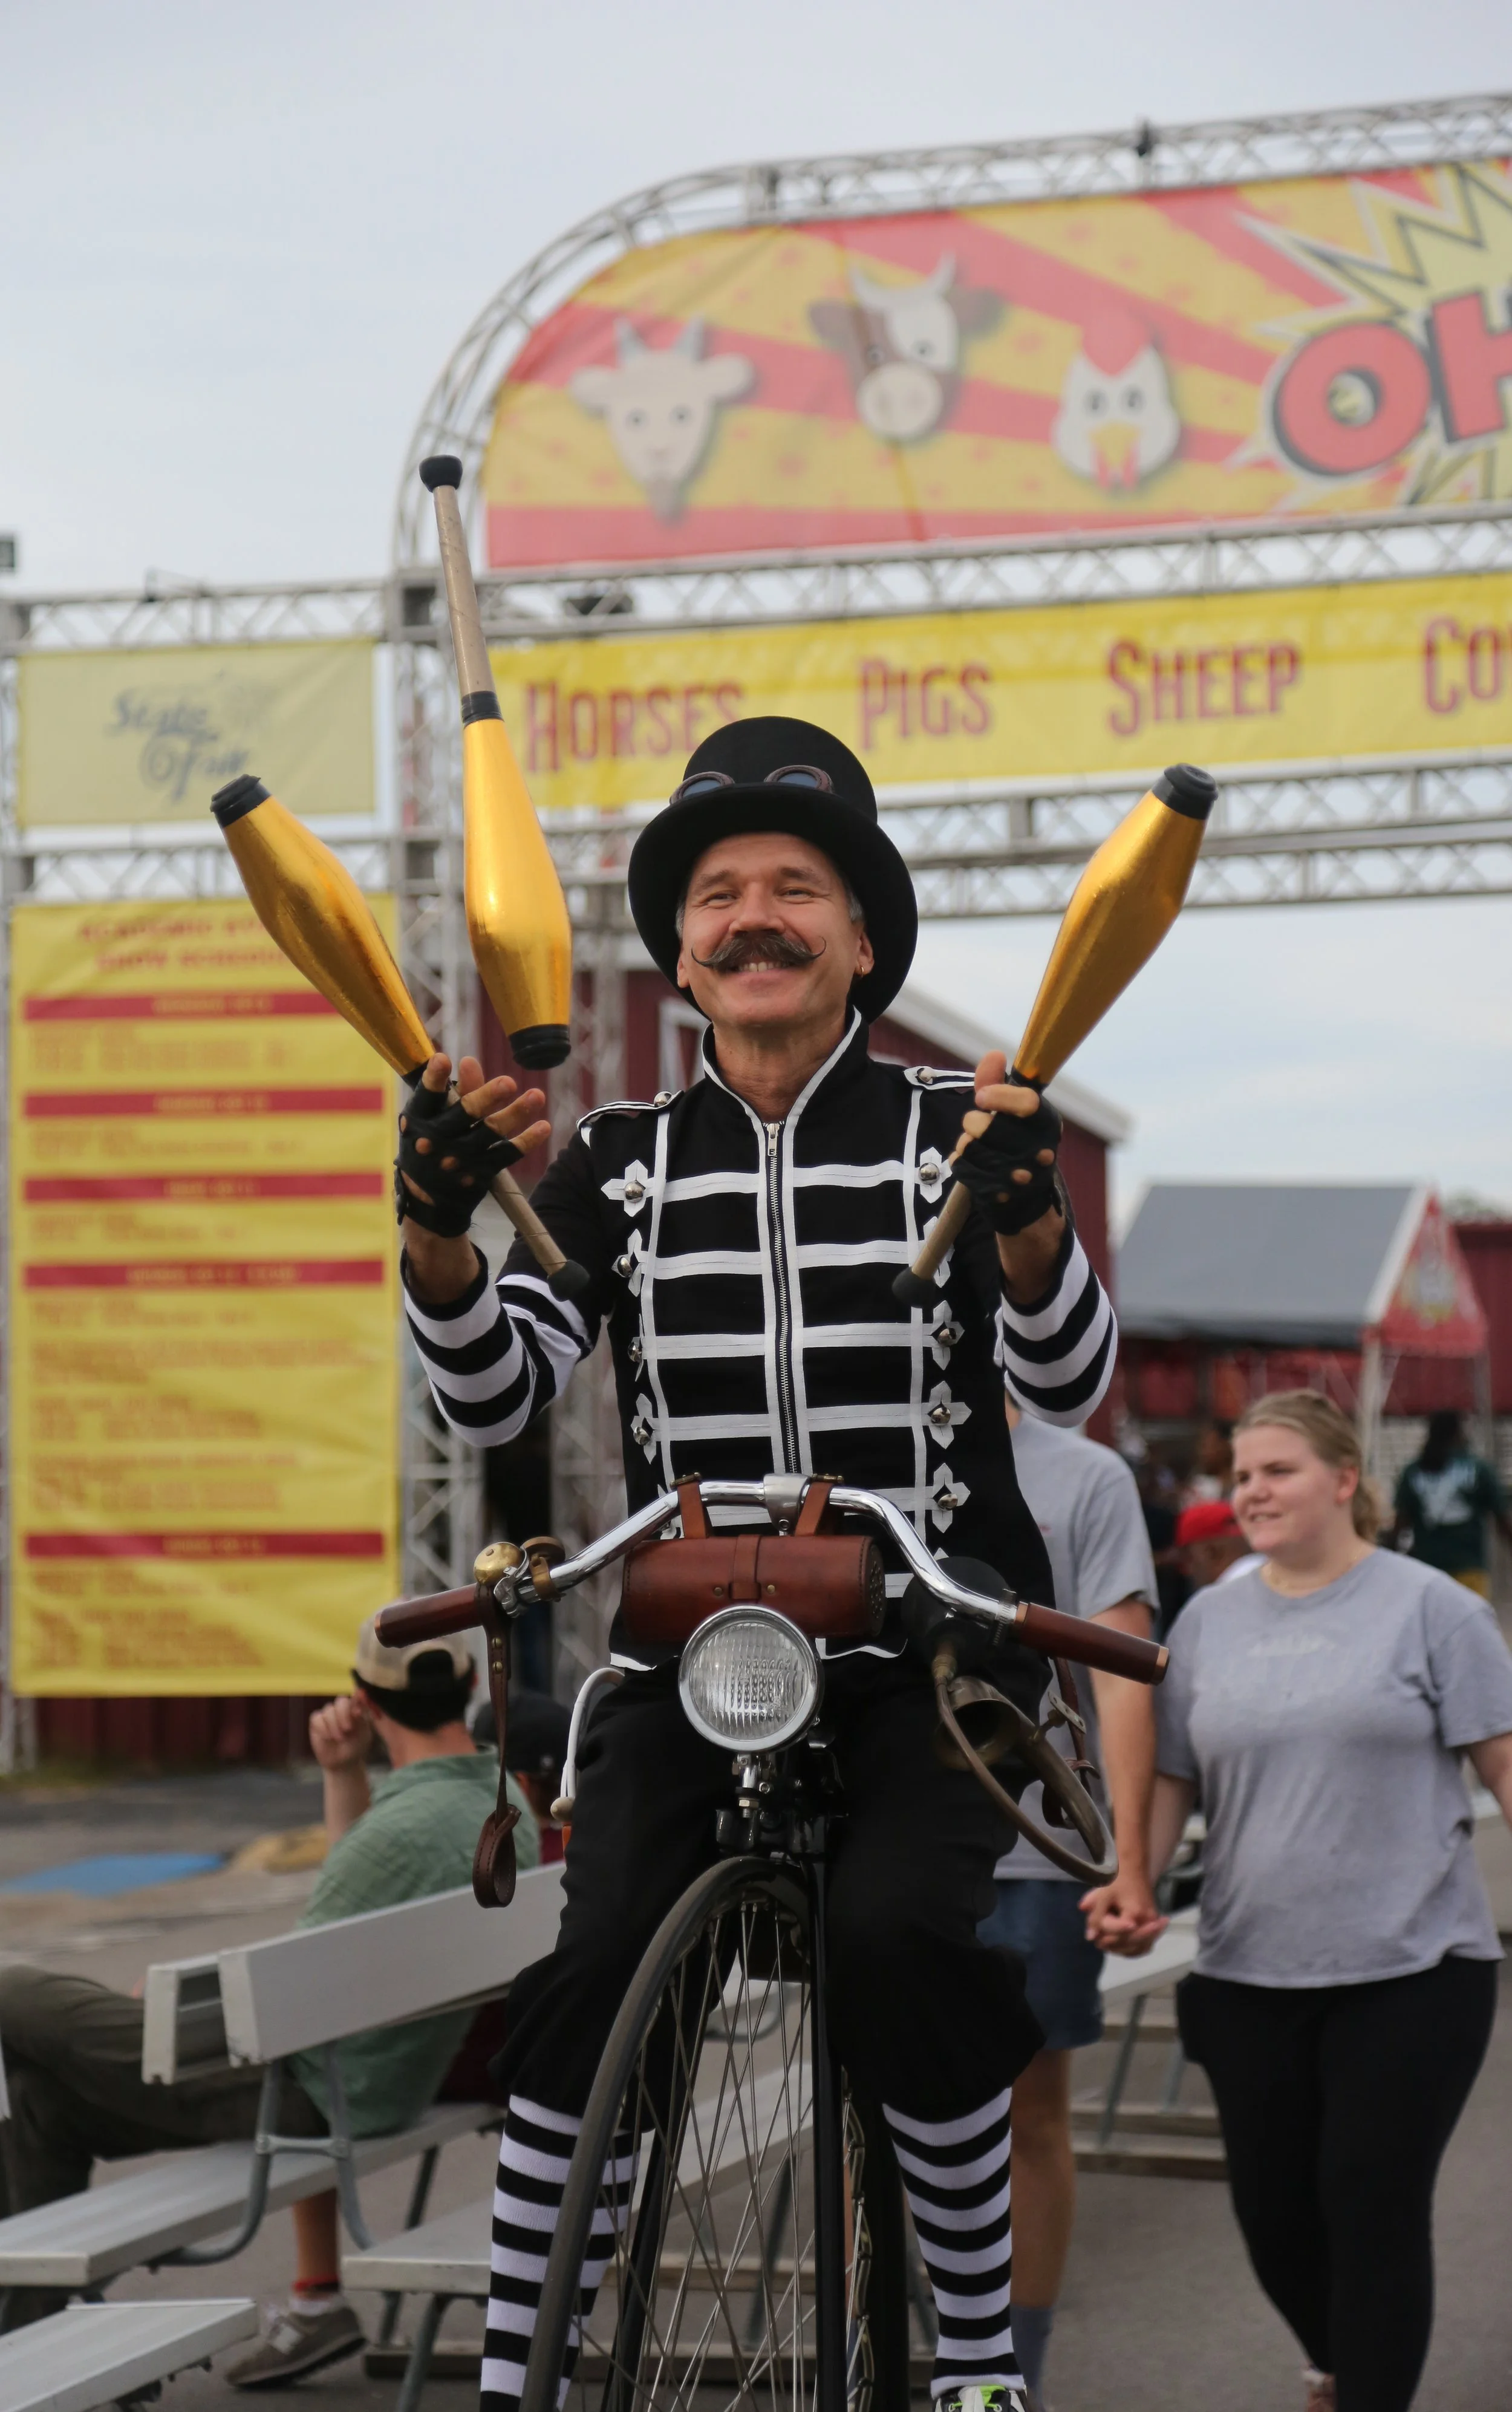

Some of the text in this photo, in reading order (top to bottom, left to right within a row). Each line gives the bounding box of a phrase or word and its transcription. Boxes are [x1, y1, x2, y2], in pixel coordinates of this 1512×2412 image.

[527, 614, 1512, 772] HORSES PIGS SHEEP CO
